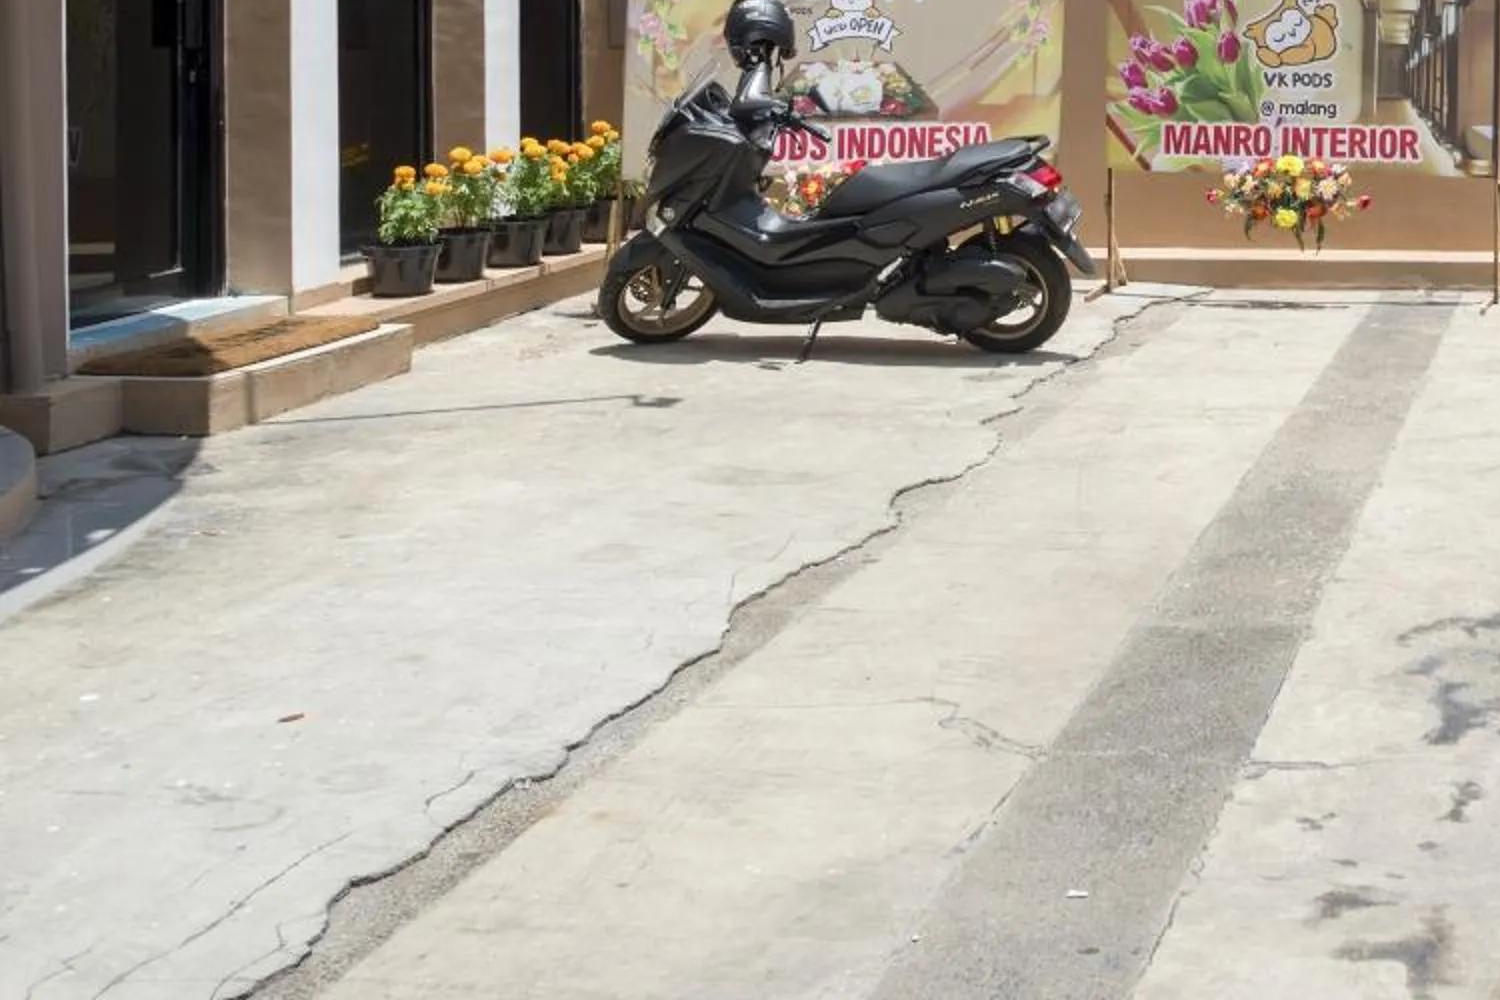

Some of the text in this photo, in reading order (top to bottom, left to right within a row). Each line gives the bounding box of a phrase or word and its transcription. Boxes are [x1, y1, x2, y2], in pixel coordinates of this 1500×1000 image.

[849, 17, 885, 35] OPEN
[1264, 72, 1332, 88] VK PODS
[1279, 101, 1337, 118] malang
[837, 124, 989, 160] INDONESIA
[1164, 124, 1419, 160] MANRO INTERIOR
